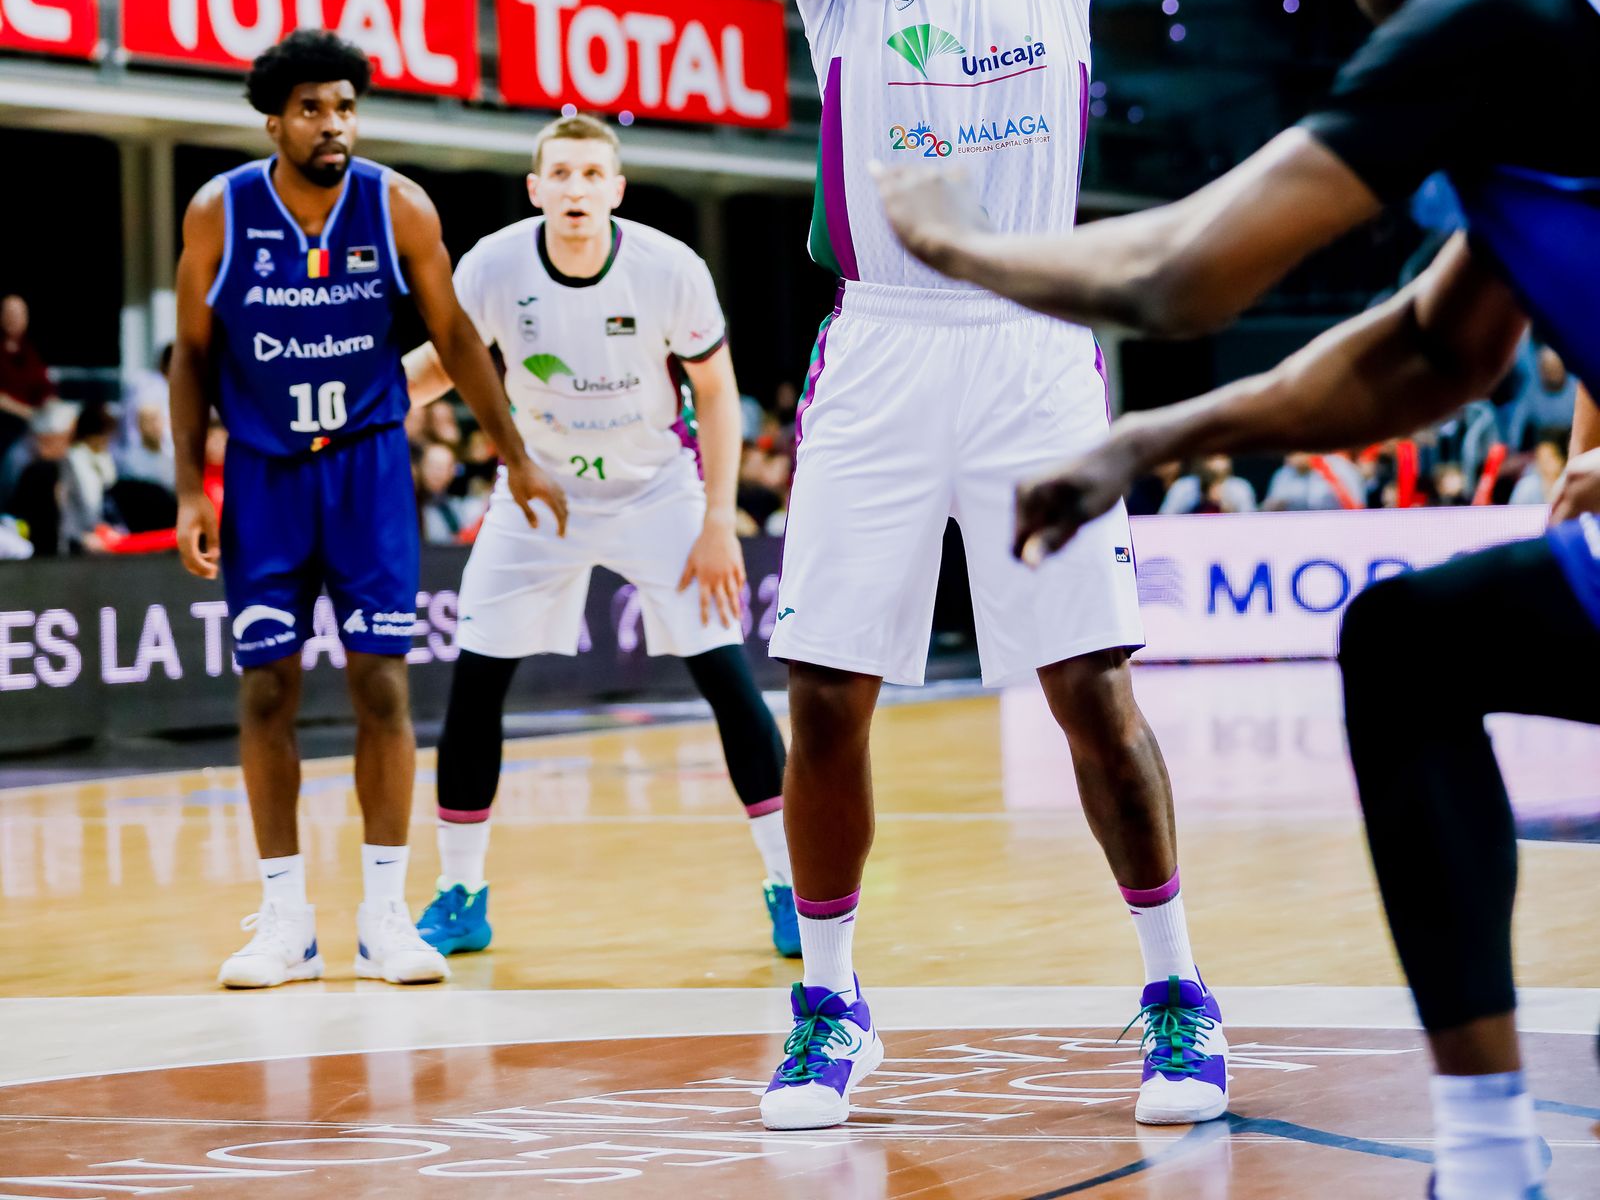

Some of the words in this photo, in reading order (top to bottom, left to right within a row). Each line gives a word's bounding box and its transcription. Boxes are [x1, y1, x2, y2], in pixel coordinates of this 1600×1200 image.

[961, 35, 1047, 77] Unicaja
[889, 124, 953, 158] 2020
[957, 114, 1050, 145] MÁLAGA
[958, 144, 994, 154] EUROPEAN
[995, 140, 1022, 150] CAPITAL
[265, 278, 384, 307] MORABANC
[283, 334, 375, 359] Andorra
[289, 380, 348, 433] 10
[569, 455, 606, 481] 21
[100, 603, 183, 684] LA
